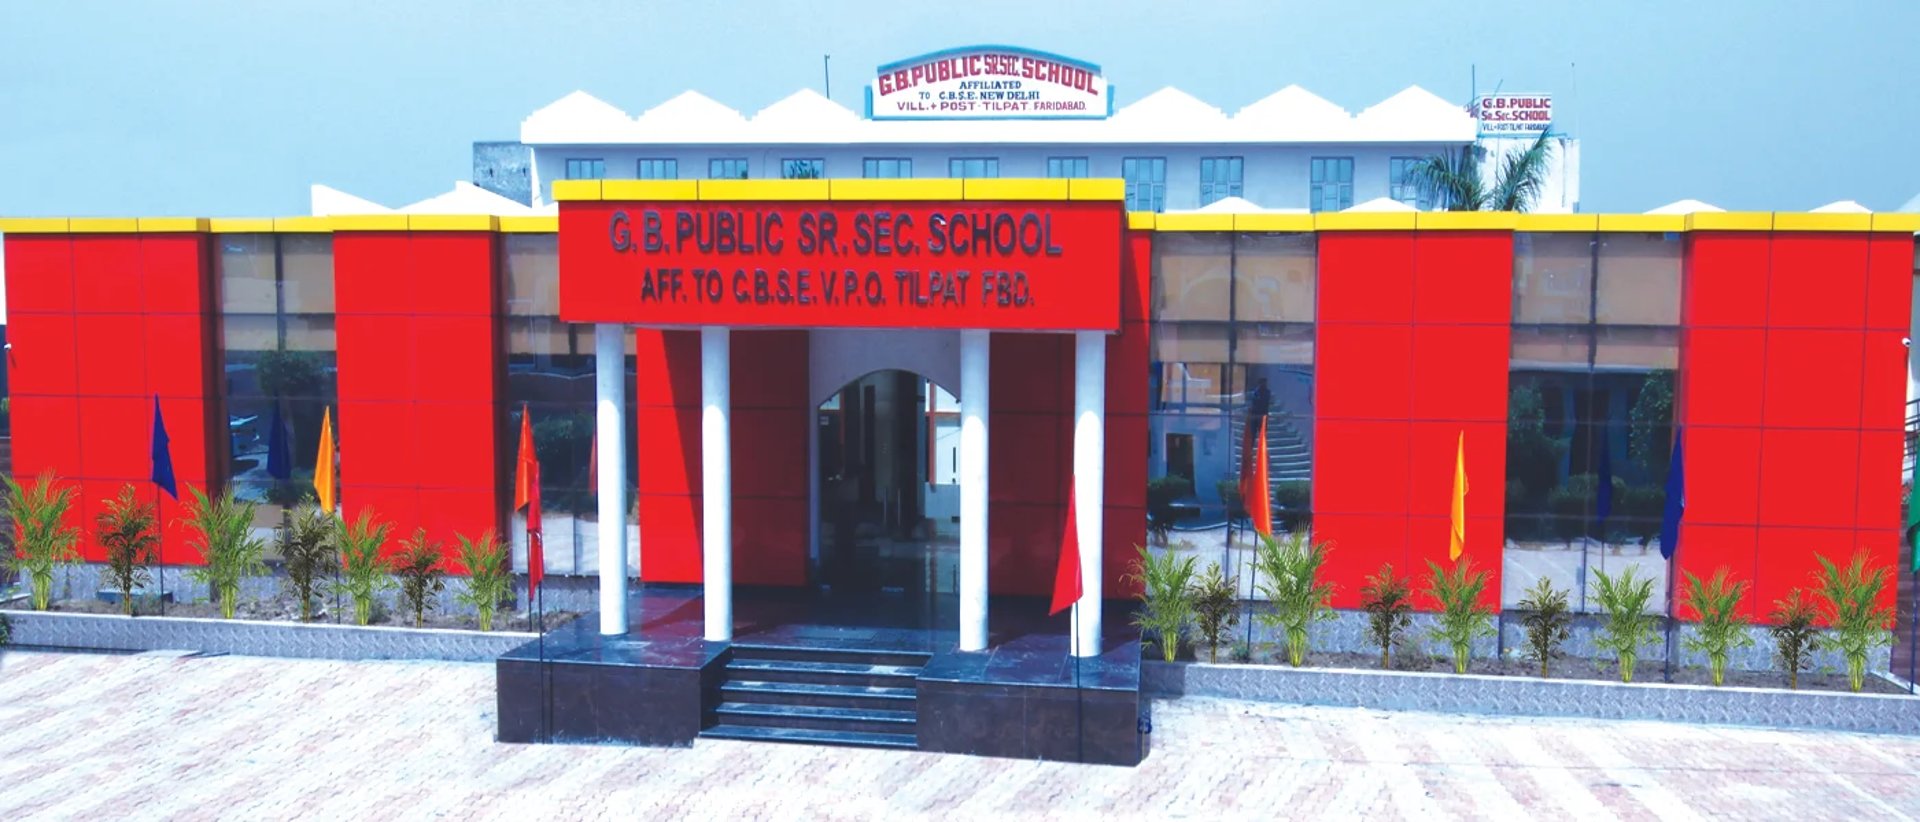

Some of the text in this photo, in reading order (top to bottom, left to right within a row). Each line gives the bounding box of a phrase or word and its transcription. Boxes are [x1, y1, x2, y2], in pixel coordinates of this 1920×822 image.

[918, 91, 931, 100] TO
[980, 91, 1004, 100] NEW
[1007, 91, 1040, 100] DELHI
[959, 80, 1022, 90] AFFILIATED
[1021, 57, 1098, 96] SCHOOL
[676, 211, 784, 254] PUBLIC
[798, 211, 848, 255] SR.
[853, 211, 920, 256] SEC.
[928, 212, 1063, 257] SCHOOL
[641, 267, 687, 302] AFF.
[692, 268, 723, 304] TO
[894, 269, 970, 307] TILPAT
[981, 270, 1034, 307] FBD.
